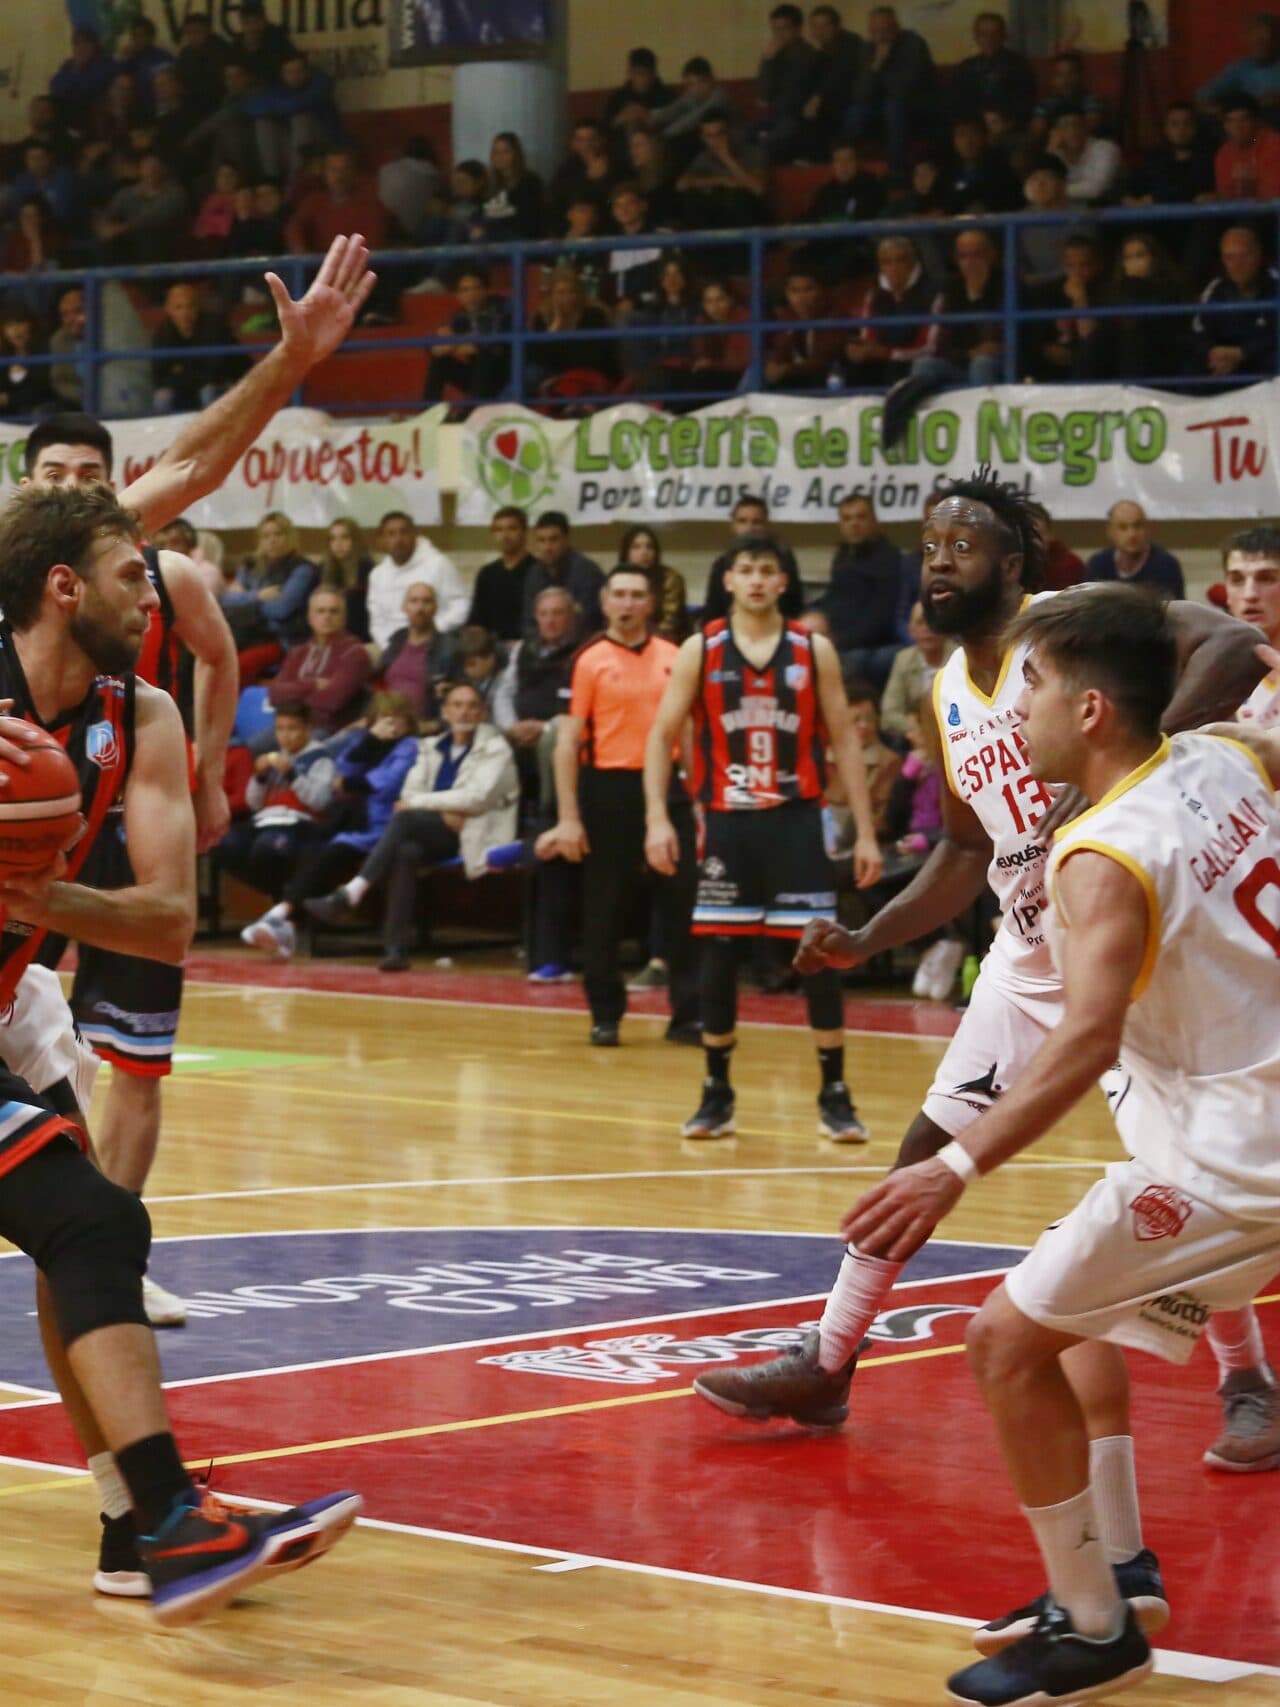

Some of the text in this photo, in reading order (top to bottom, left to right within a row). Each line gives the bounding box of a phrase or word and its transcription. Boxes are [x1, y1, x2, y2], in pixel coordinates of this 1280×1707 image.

[242, 428, 424, 508] apuesta!
[793, 415, 849, 470] de
[976, 399, 1167, 487] Negro
[1184, 416, 1269, 485] Tu
[750, 730, 773, 764] 9
[970, 710, 1014, 740] CENTR
[1002, 773, 1054, 835] 13
[179, 1249, 664, 1318] PATAGONI
[387, 1262, 781, 1315] BANCO
